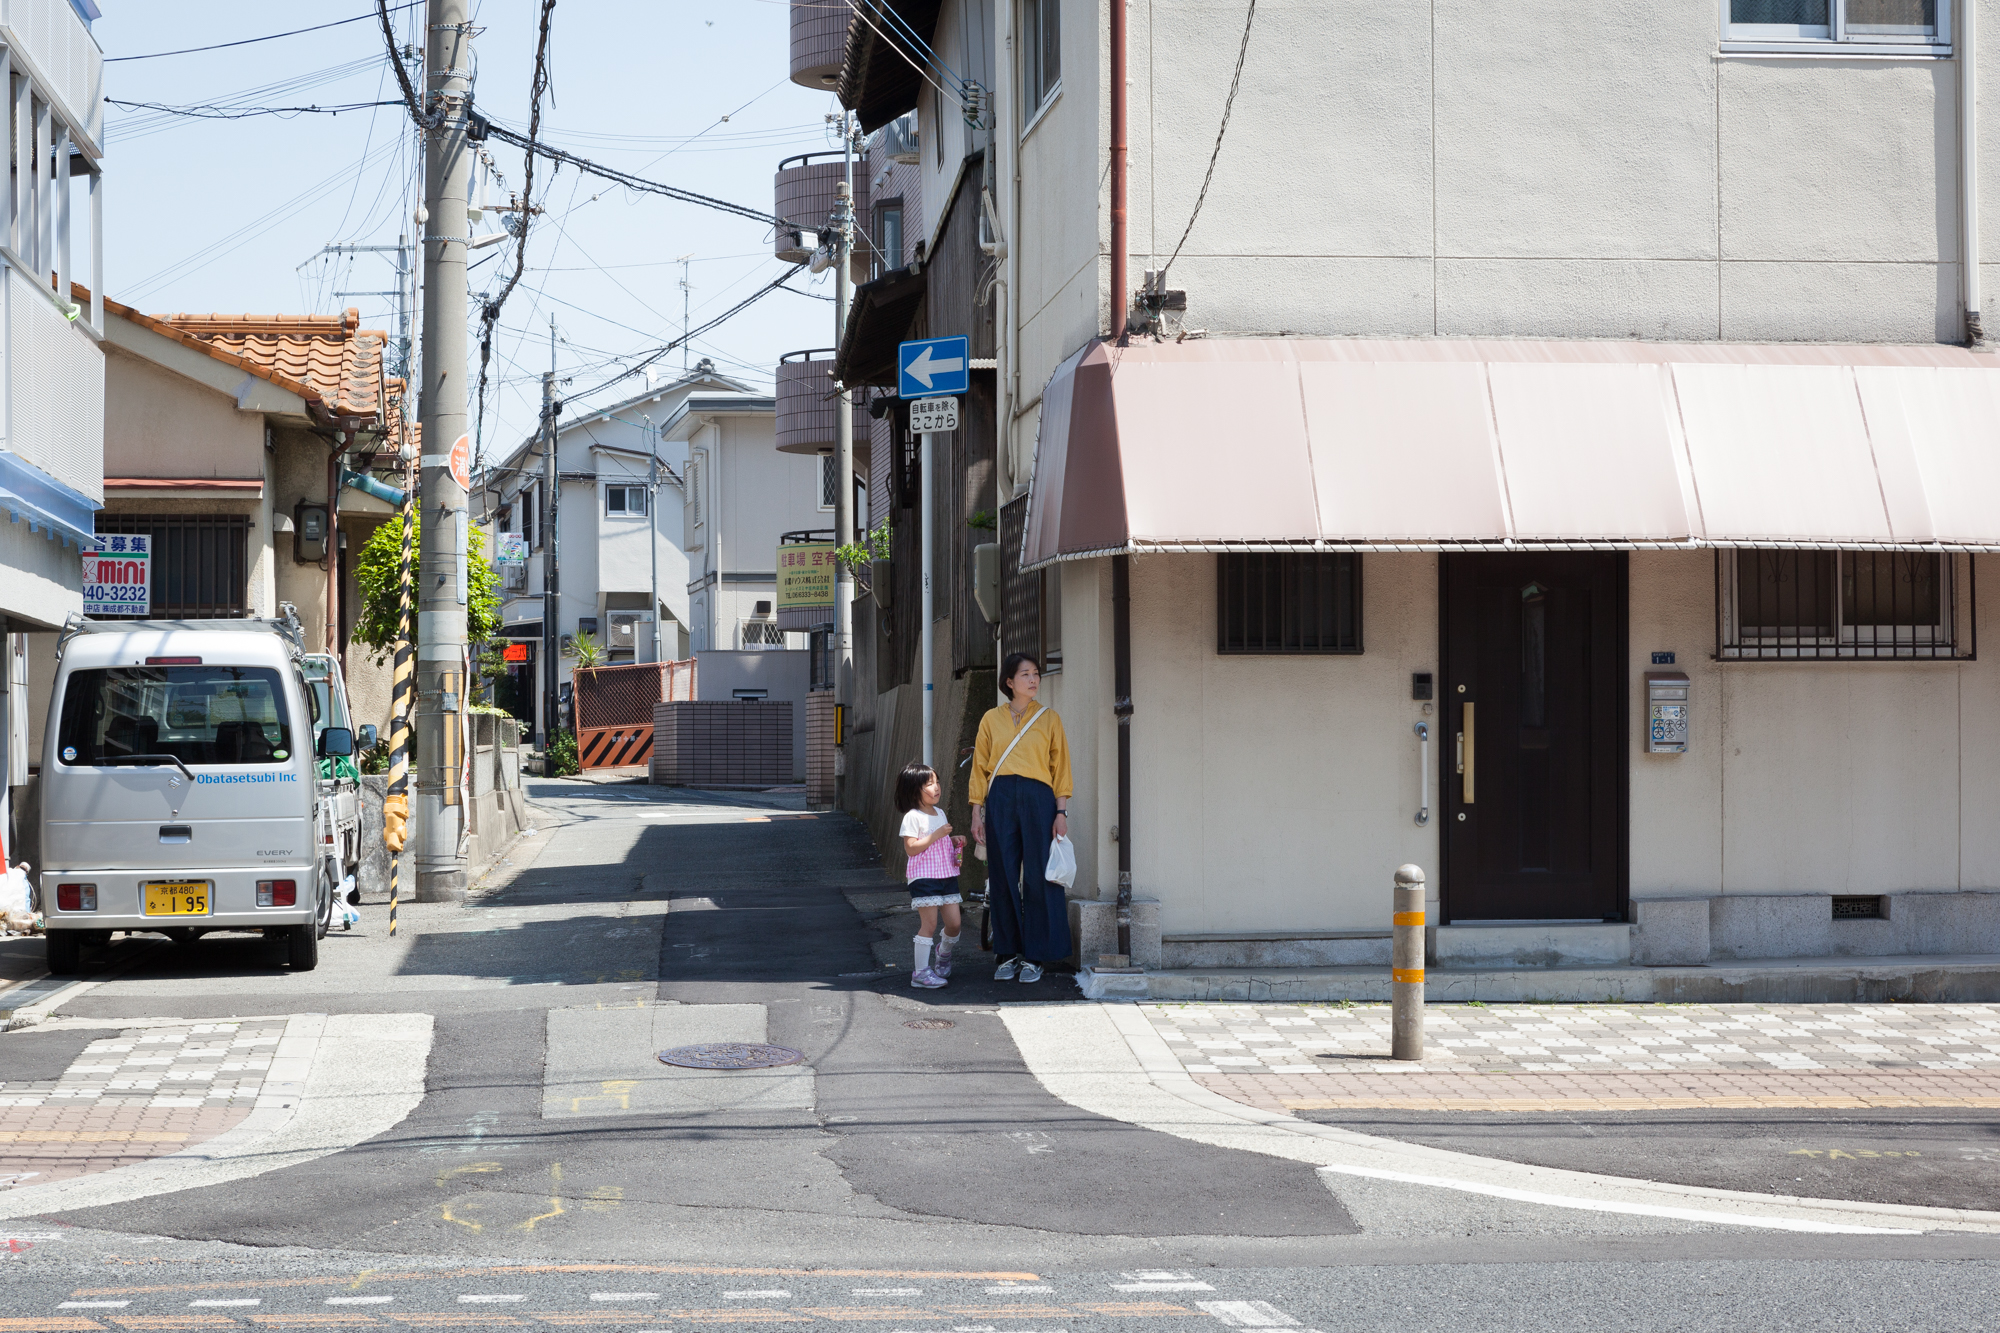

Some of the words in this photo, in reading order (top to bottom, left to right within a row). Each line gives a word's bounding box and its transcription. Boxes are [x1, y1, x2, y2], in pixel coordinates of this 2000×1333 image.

[912, 401, 955, 414] 自転車を除く
[912, 414, 956, 430] ここから
[83, 536, 147, 553] 者募集
[781, 552, 806, 568] 駐車場
[83, 604, 100, 613] 中店
[197, 773, 275, 784] Obatasetsubi
[279, 773, 297, 782] Inc
